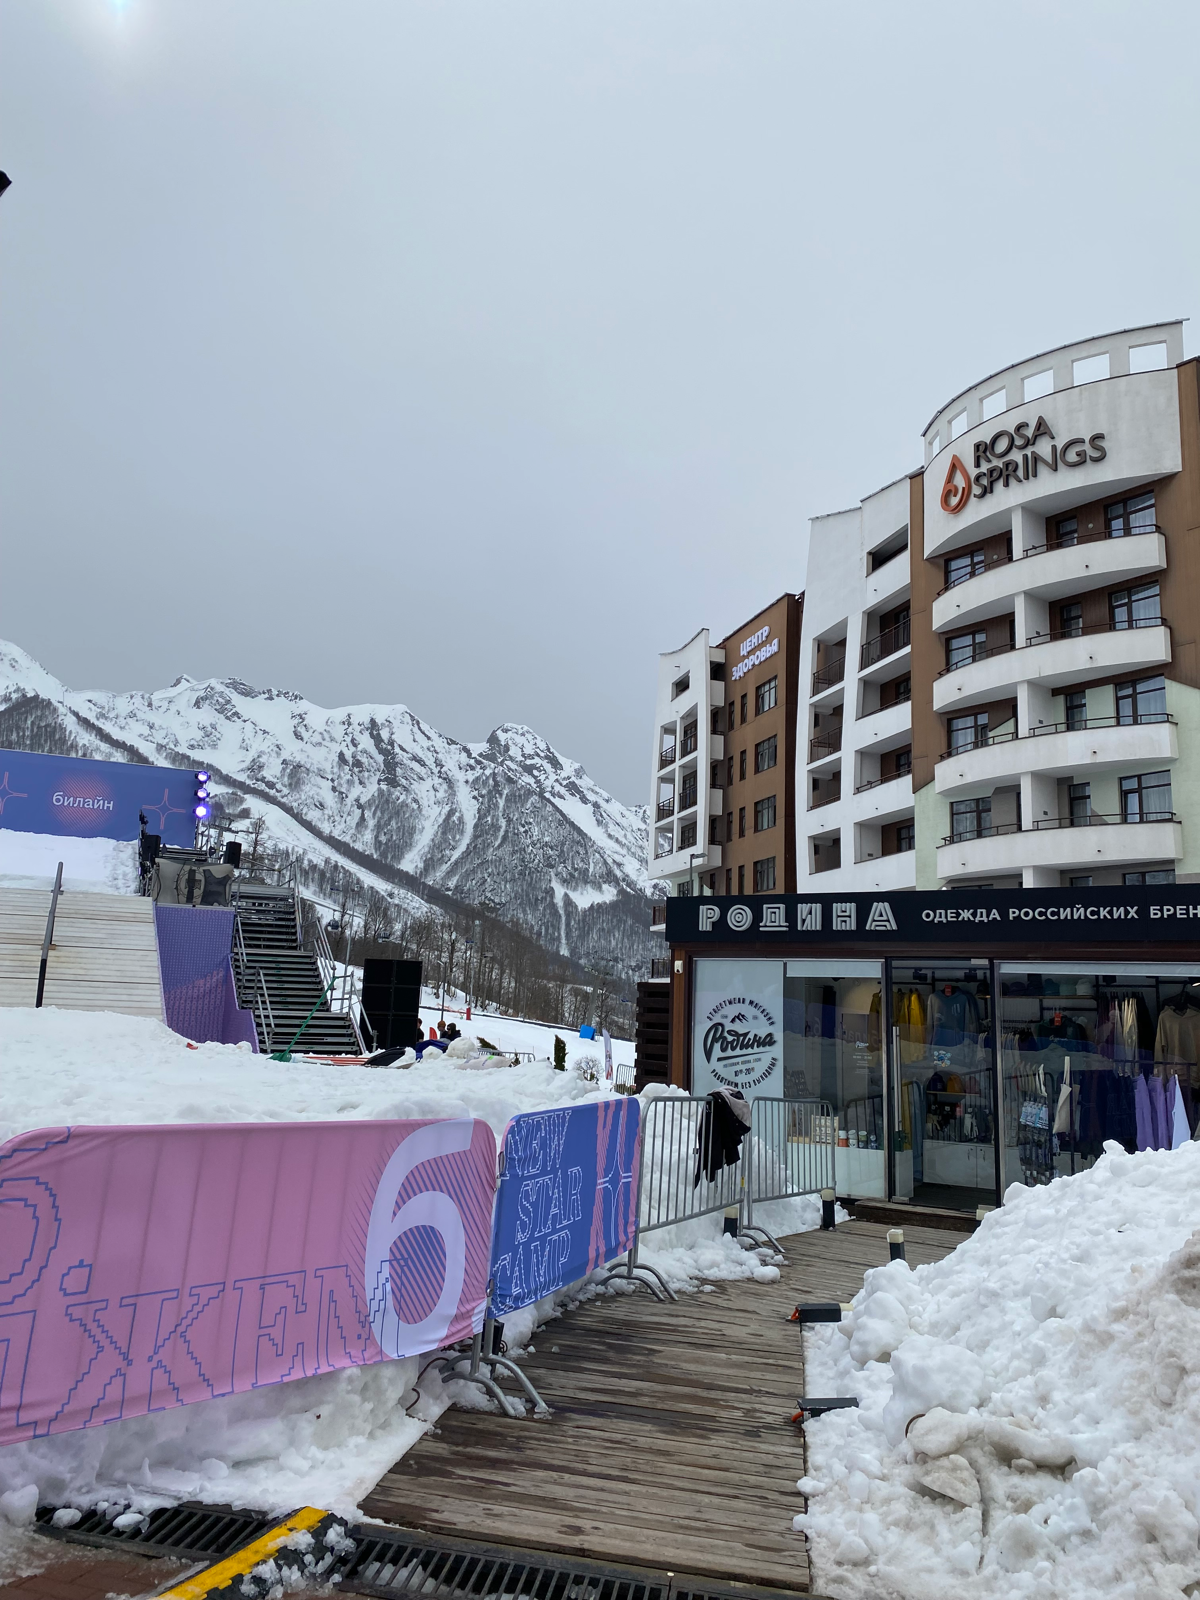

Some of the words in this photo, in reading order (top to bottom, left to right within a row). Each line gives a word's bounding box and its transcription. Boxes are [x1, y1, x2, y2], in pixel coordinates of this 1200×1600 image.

[973, 415, 1055, 468] ROSA
[973, 433, 1107, 499] SPRINGS
[731, 638, 779, 680] ЗДОРОВЬЯ
[740, 625, 770, 656] ЦЕНТР
[52, 791, 114, 811] билайн
[698, 902, 898, 931] РОДИНА
[921, 908, 1001, 923] ОДЕЖДА
[1009, 904, 1139, 920] РОССИЙСКИХ
[703, 1022, 777, 1064] Родина
[741, 1081, 752, 1090] БЕЗ
[501, 1110, 572, 1179] NEW
[515, 1166, 582, 1244] STAR
[490, 1229, 571, 1317] CAMP
